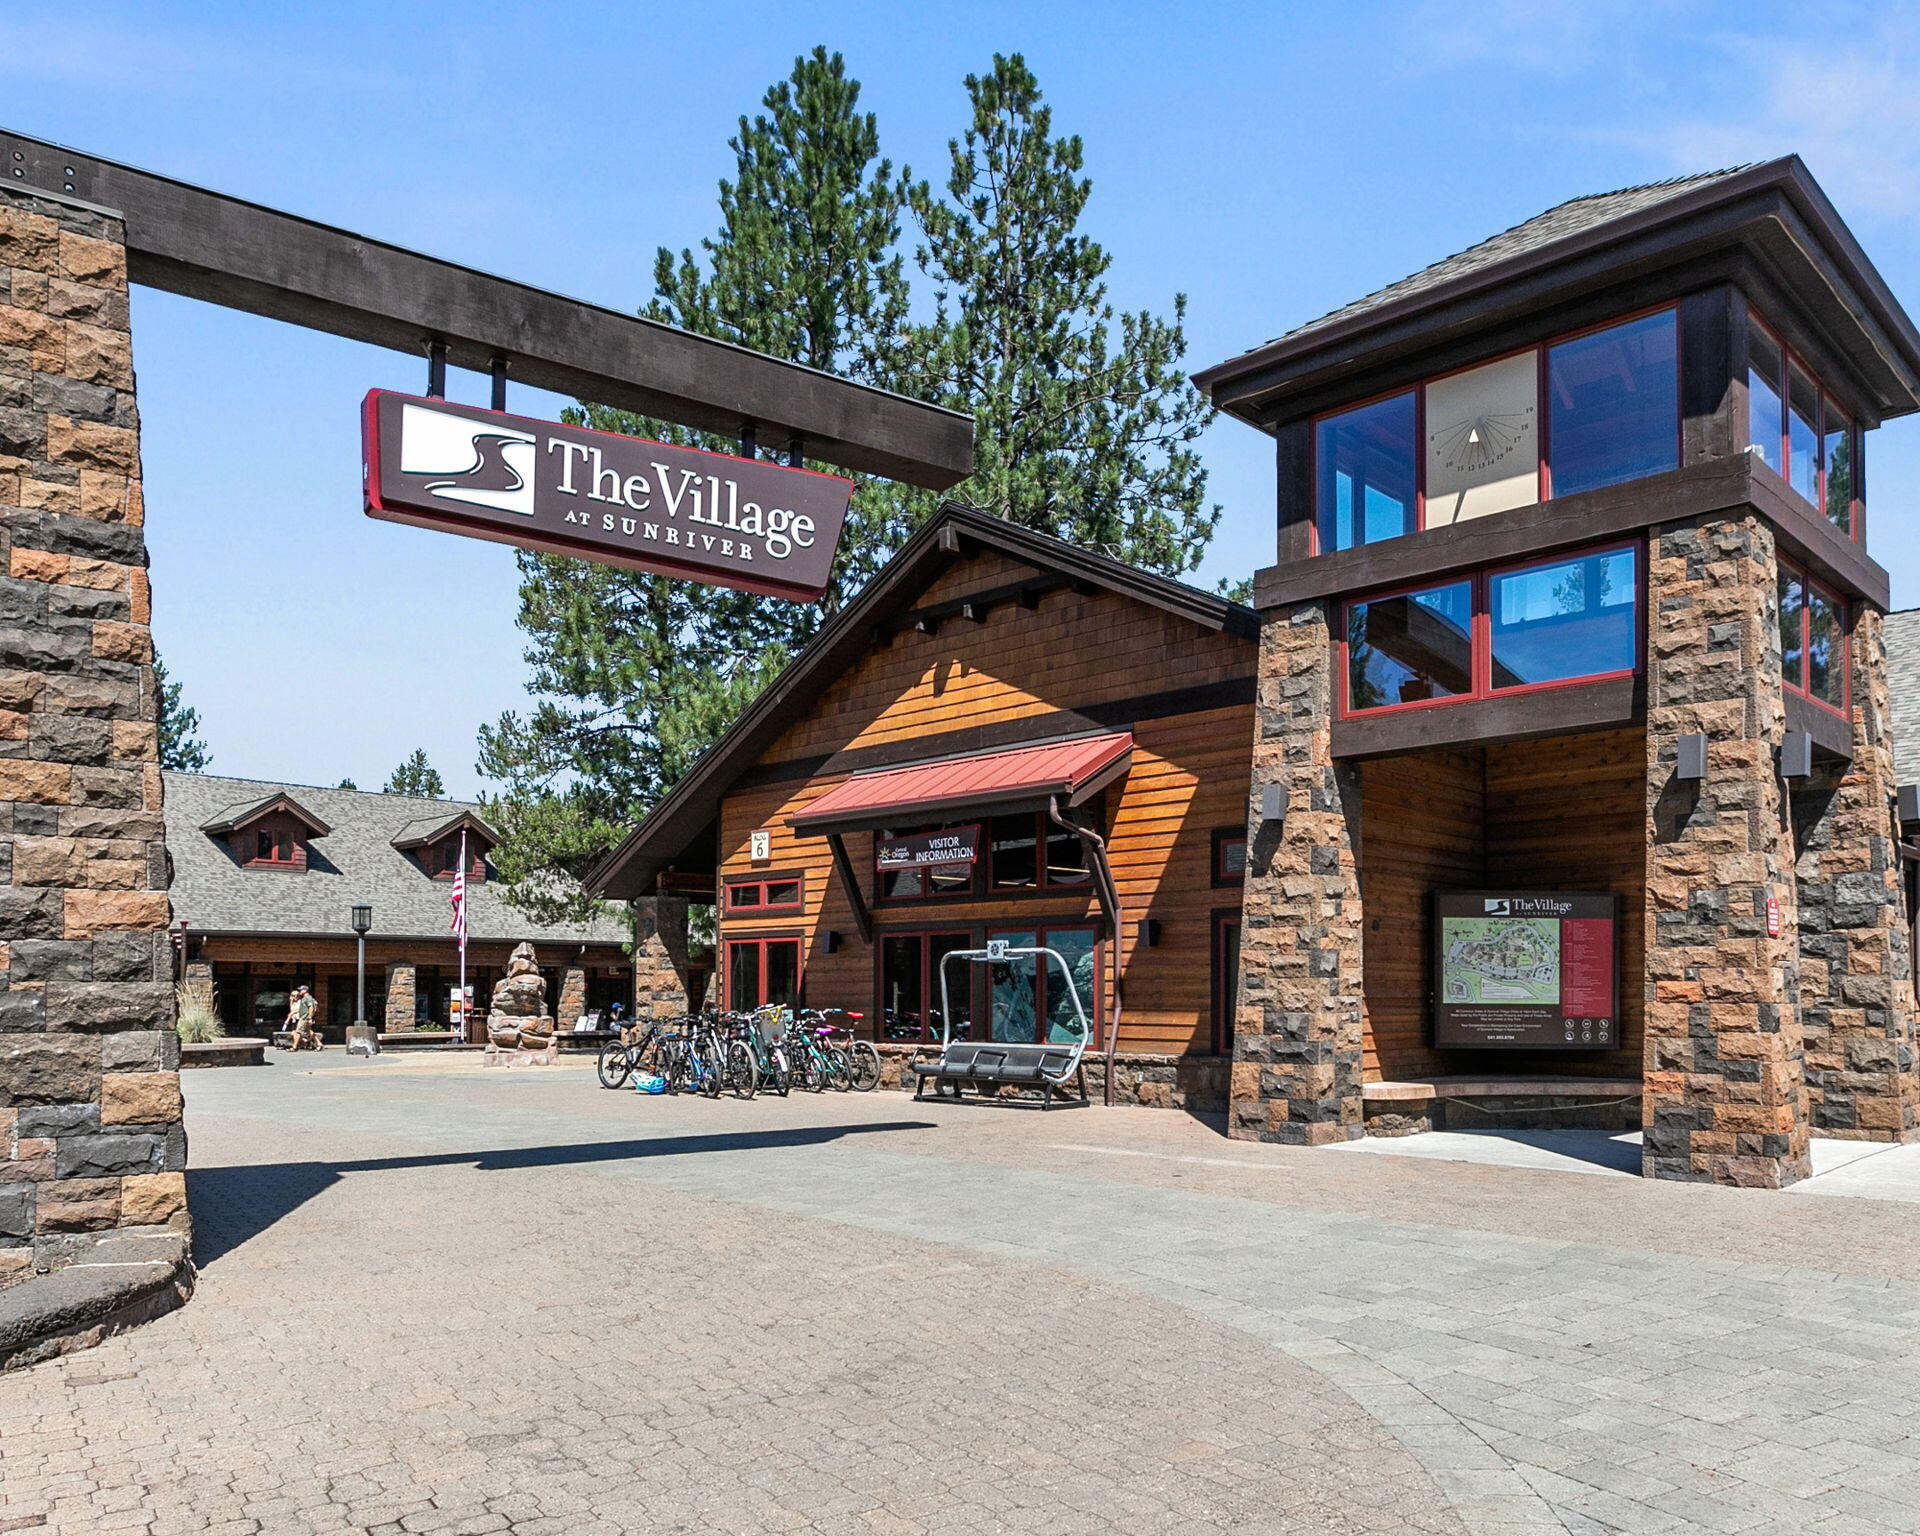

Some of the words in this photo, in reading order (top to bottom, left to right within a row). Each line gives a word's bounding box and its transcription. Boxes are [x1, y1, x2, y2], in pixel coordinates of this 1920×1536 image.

[547, 437, 650, 512] The
[650, 462, 816, 559] Village
[564, 510, 591, 527] AT
[602, 513, 754, 560] SUNRIVER
[757, 842, 764, 857] 6
[929, 836, 959, 848] VISITOR
[915, 846, 974, 862] INFORMATION
[1534, 898, 1572, 914] Village
